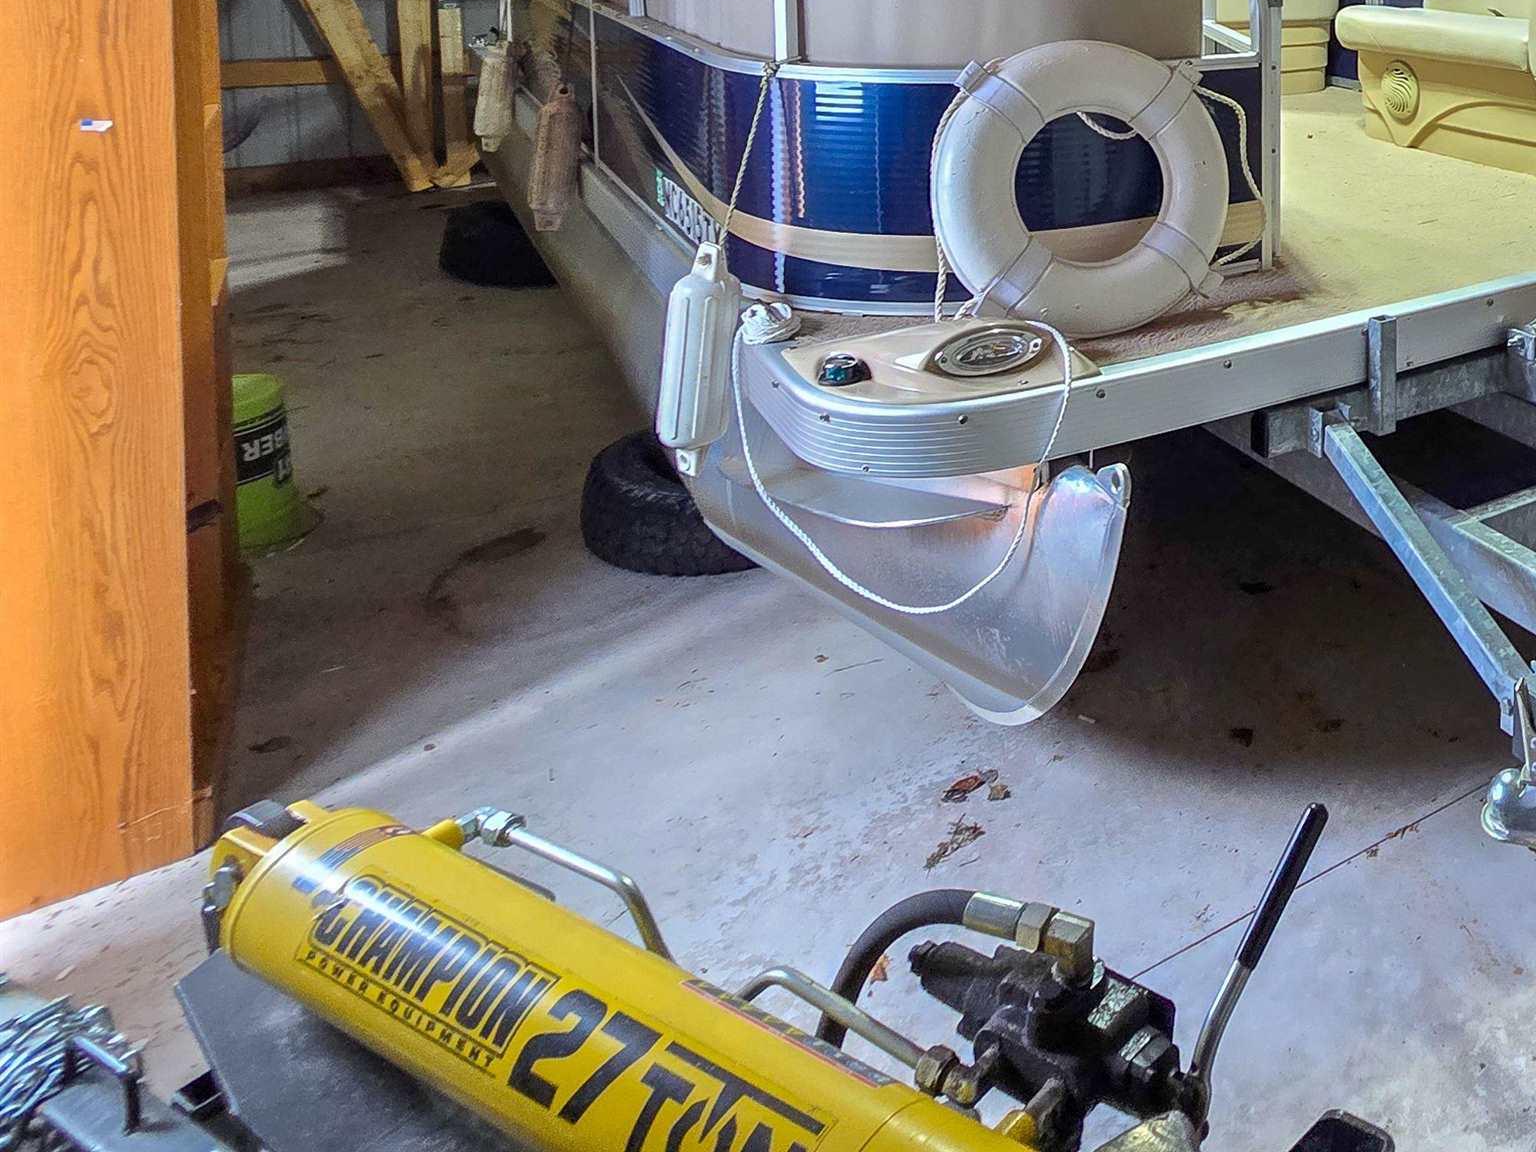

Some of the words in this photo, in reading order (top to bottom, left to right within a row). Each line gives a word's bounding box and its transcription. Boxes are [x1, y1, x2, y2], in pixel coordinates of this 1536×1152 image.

[304, 948, 371, 996] POWER
[375, 987, 497, 1069] EQUIPMENT
[309, 877, 553, 1049] CHAMPION
[507, 988, 663, 1126] 27
